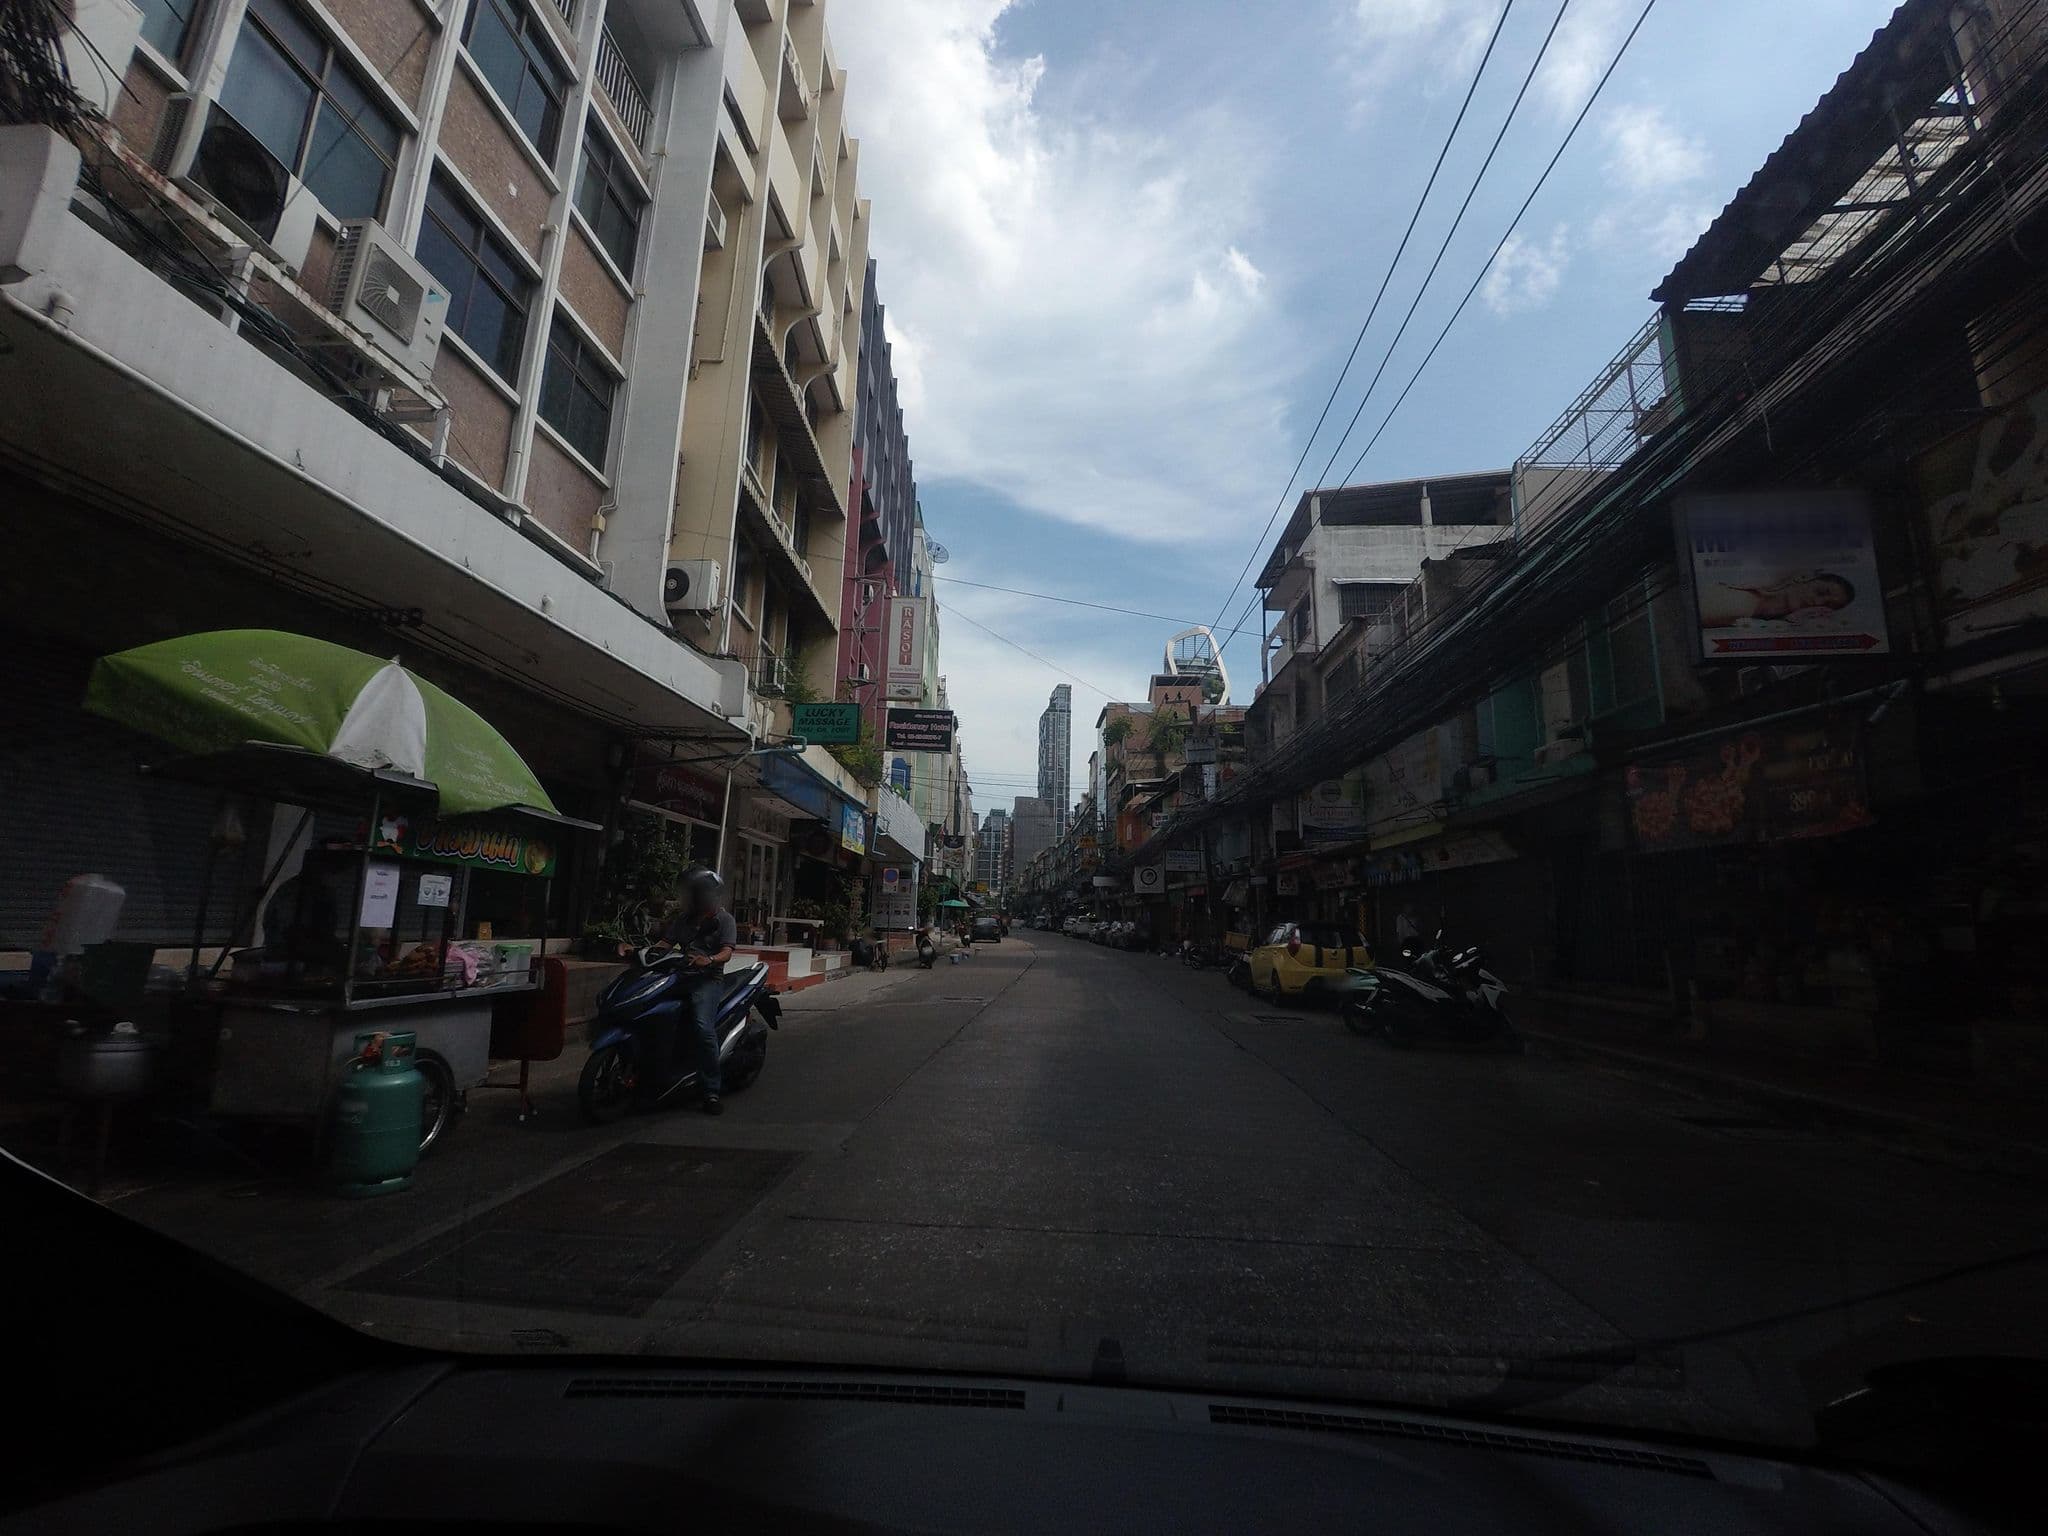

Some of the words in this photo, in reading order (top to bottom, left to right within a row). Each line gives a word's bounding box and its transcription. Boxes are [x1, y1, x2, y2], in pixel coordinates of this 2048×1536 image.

[901, 607, 912, 664] RASOI
[806, 708, 847, 717] LUCKY
[798, 718, 850, 726] MASSAGE
